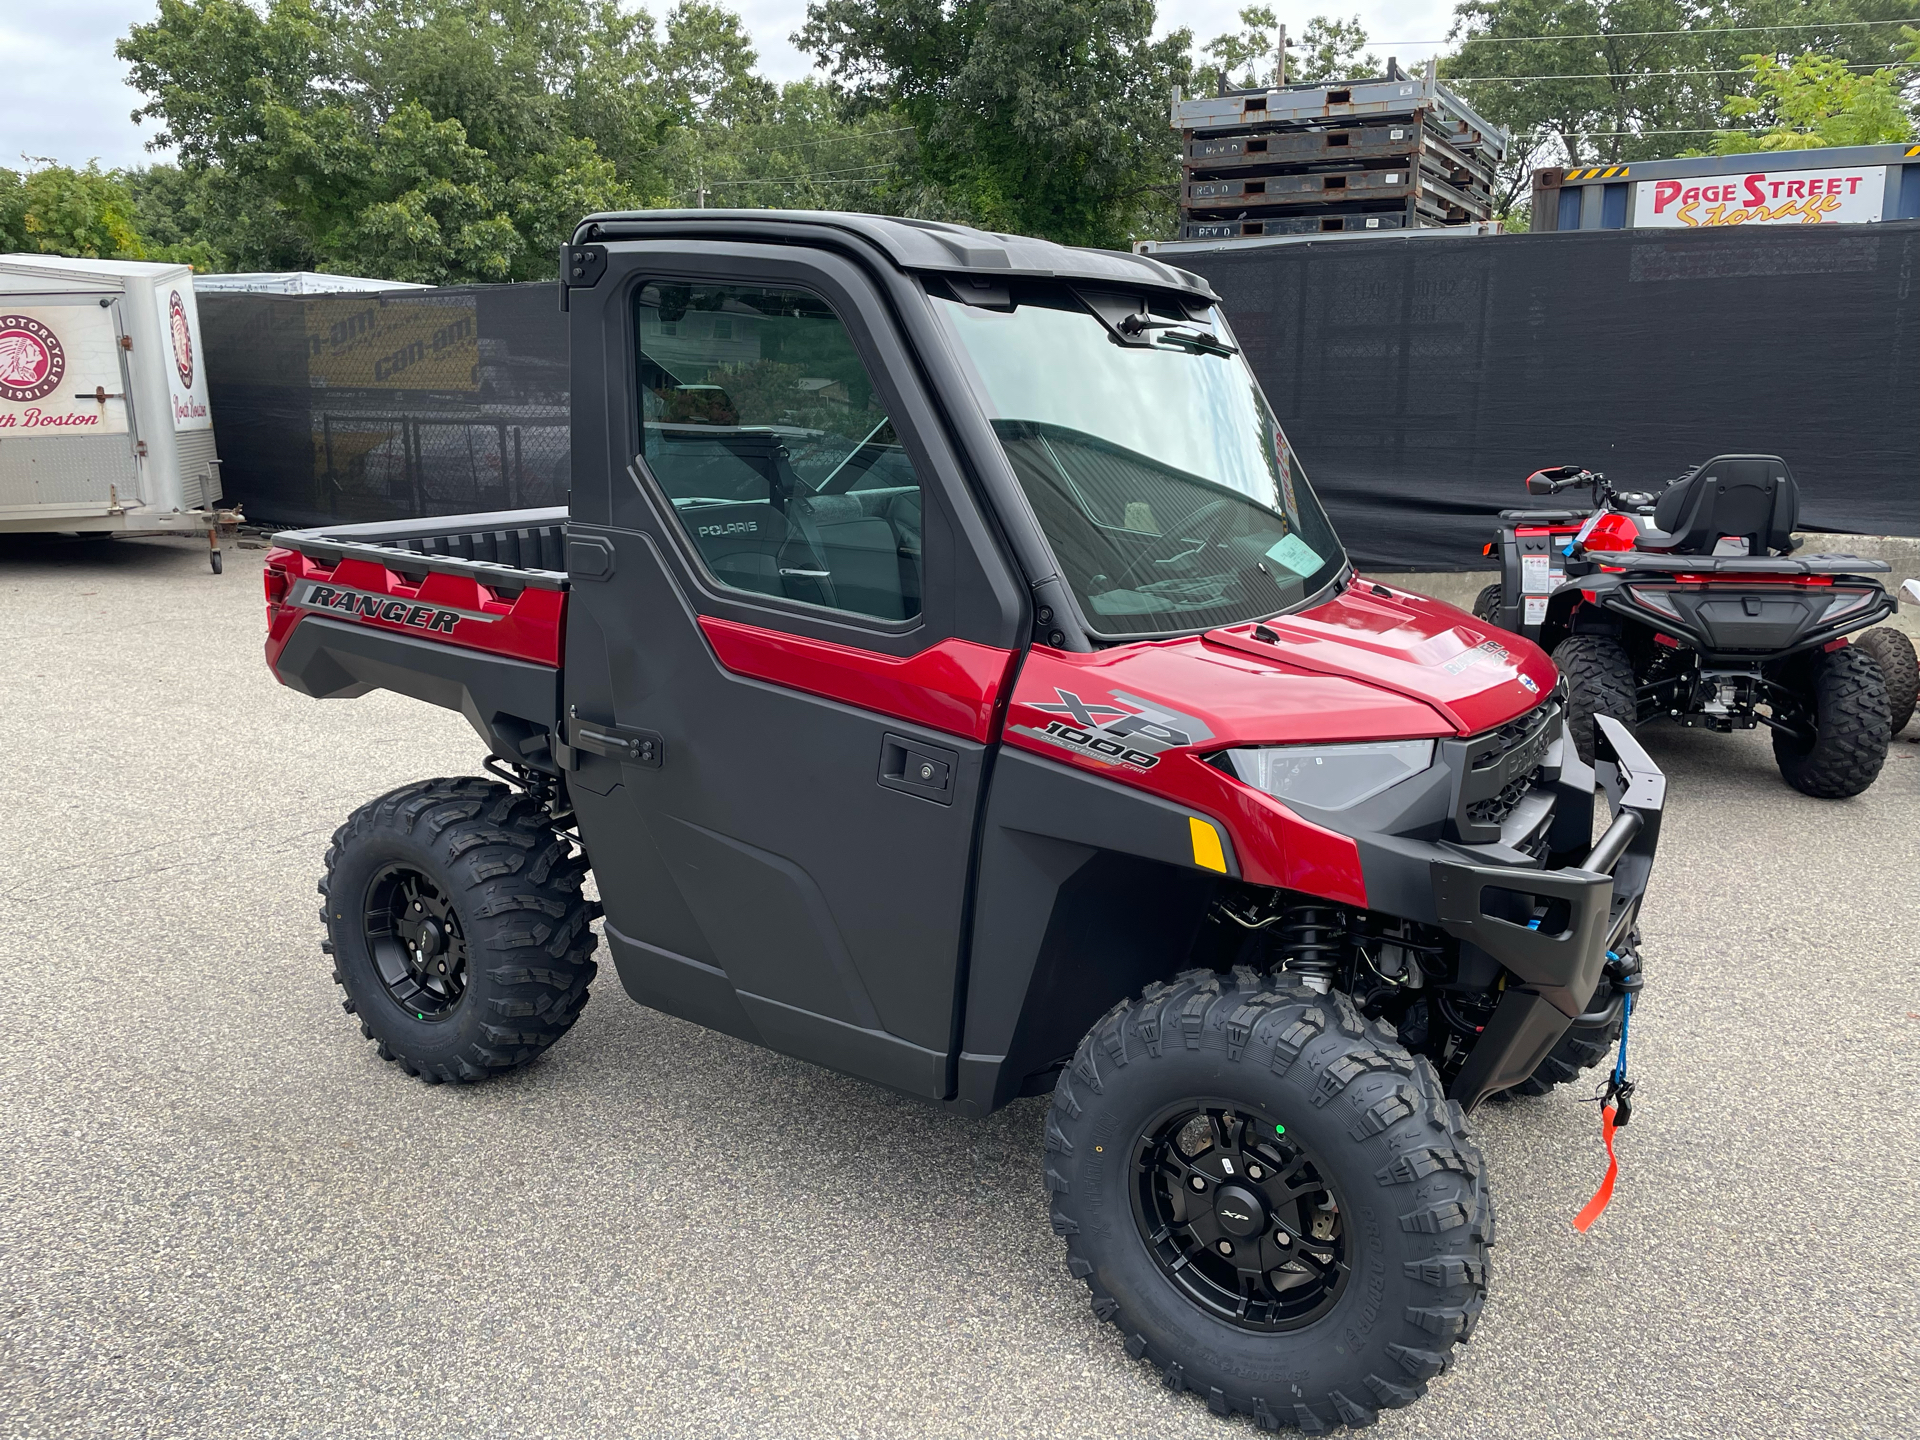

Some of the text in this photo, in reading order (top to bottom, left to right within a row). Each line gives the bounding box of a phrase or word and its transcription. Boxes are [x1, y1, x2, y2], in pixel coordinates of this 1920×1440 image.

[1654, 174, 1863, 214] PAGE STREET
[1677, 194, 1842, 227] Storage
[1198, 227, 1218, 237] REV
[8, 387, 41, 399] 1901
[20, 407, 99, 428] Boston
[698, 520, 758, 538] POLARIS
[307, 584, 461, 634] RANGER
[1442, 640, 1505, 676] RANGER
[1489, 648, 1511, 667] XP
[1019, 686, 1193, 748] XP
[1040, 734, 1147, 776] DUAL OVERHEAD CAM
[1044, 720, 1161, 770] 1000
[1220, 1208, 1250, 1222] XP
[1356, 1205, 1386, 1336] PRO ARMOR
